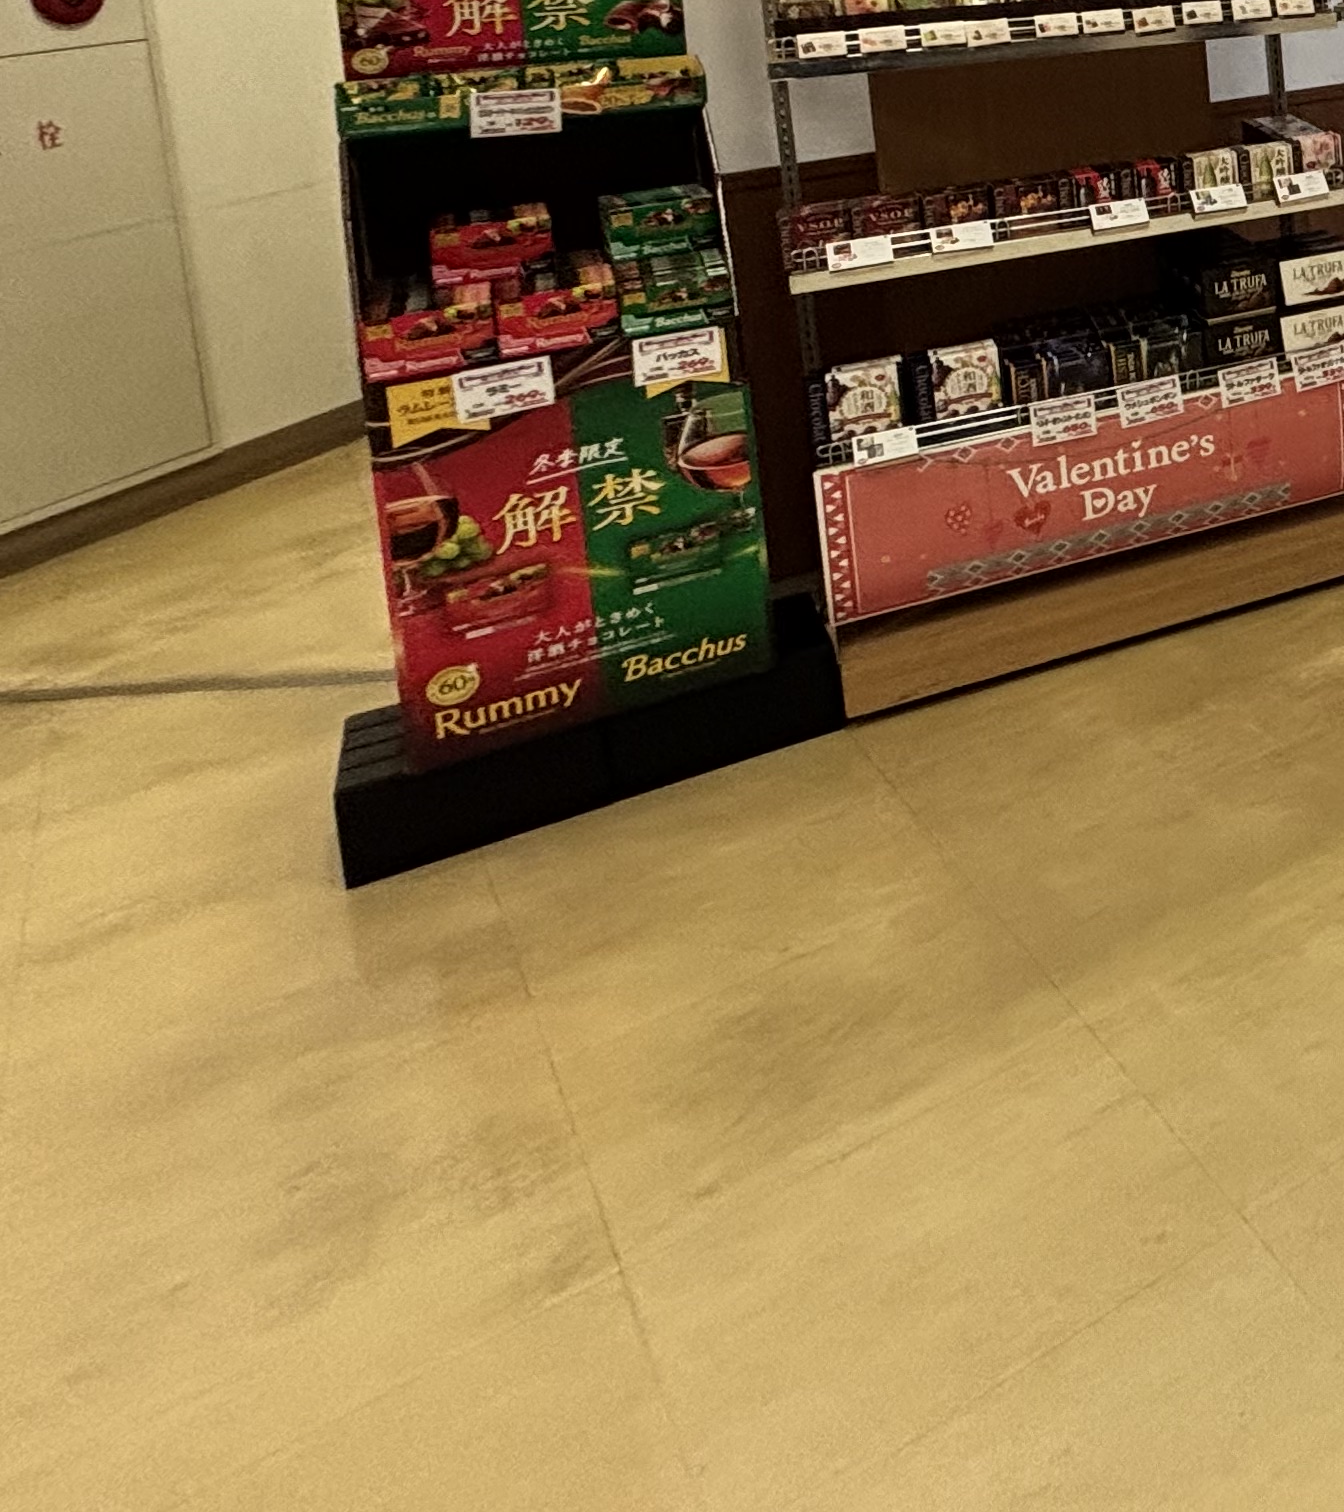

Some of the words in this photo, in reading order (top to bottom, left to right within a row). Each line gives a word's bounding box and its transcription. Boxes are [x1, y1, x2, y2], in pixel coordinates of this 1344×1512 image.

[1214, 280, 1229, 296] LA
[1231, 273, 1268, 291] TRUFA
[1293, 267, 1306, 280] LA
[1306, 260, 1344, 282] TRUFA
[1217, 336, 1233, 352] LA
[1235, 329, 1271, 348] TRUFA
[1293, 323, 1306, 336] LA
[1306, 314, 1344, 337] TRUFA
[655, 348, 701, 364] バッカス
[532, 437, 625, 475] 冬季限定
[1006, 434, 1216, 499] Valentine's
[492, 467, 667, 556] 解禁
[1079, 483, 1158, 522] Day
[621, 631, 748, 685] Bacchus
[433, 678, 582, 740] Rummy
